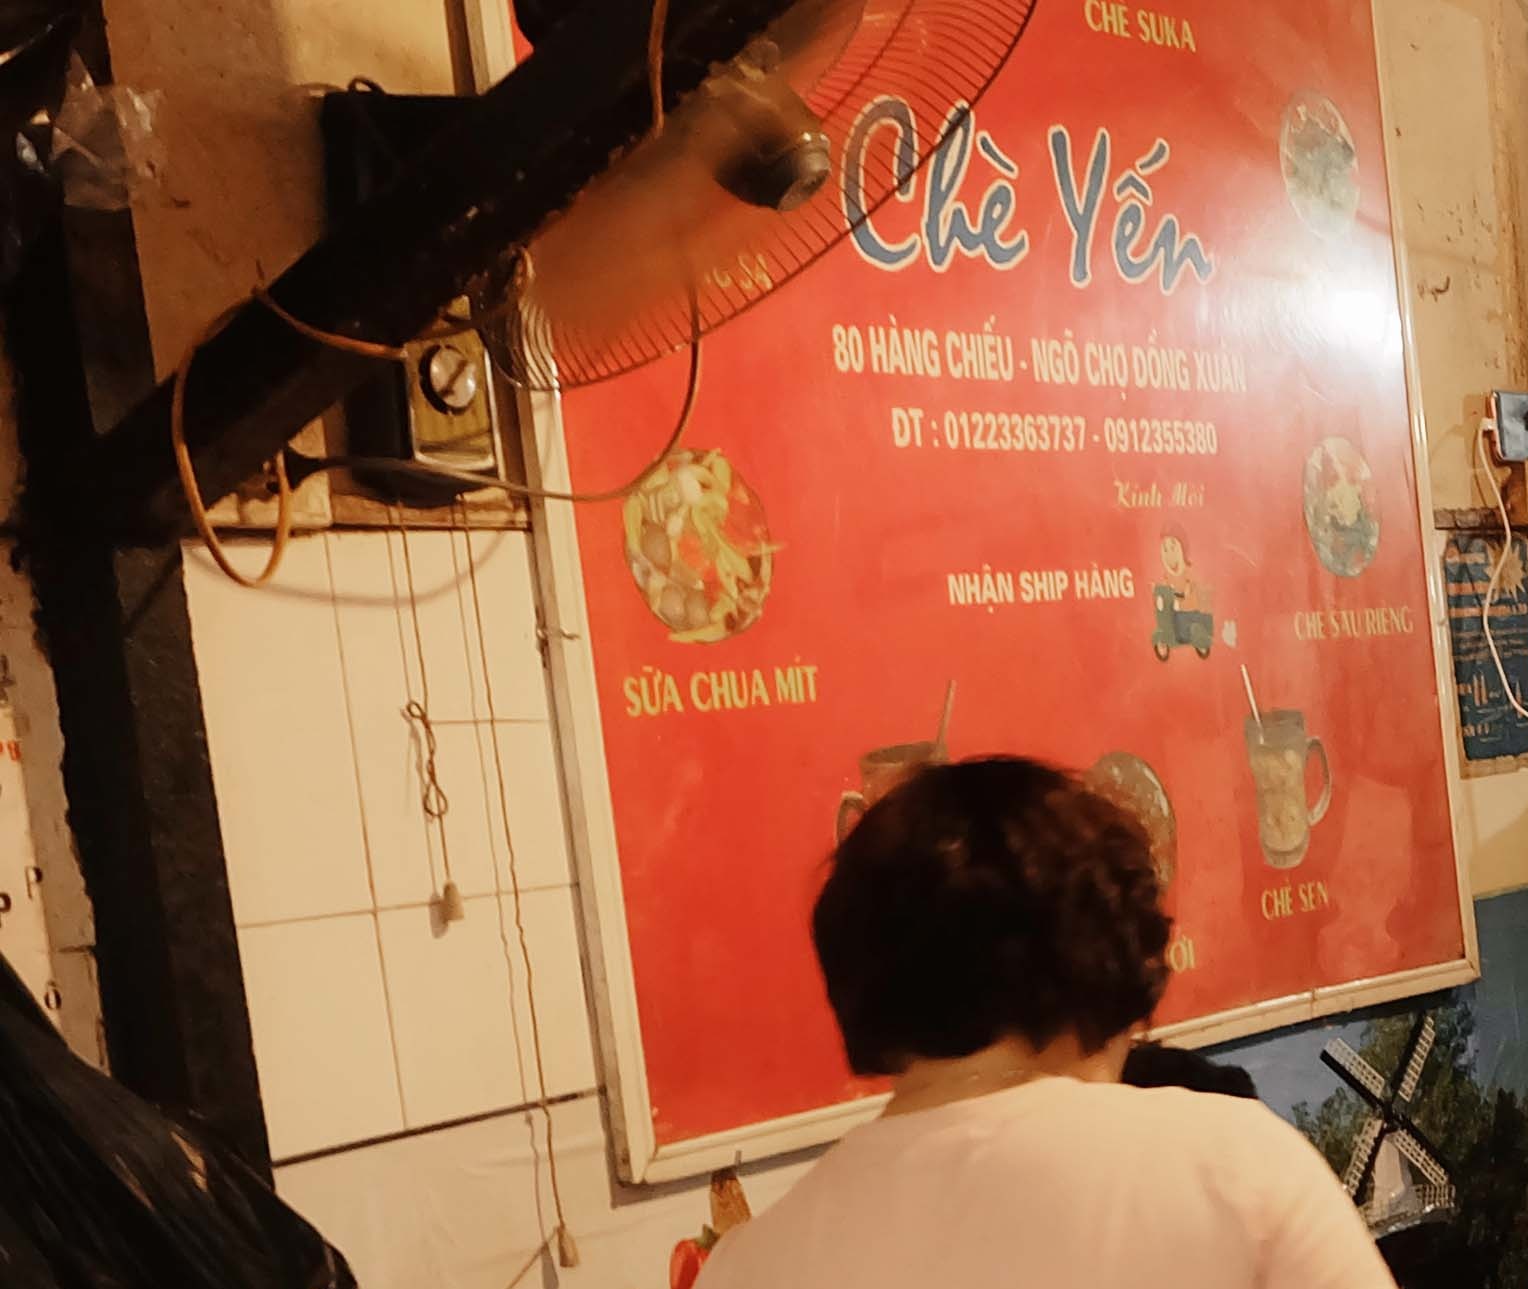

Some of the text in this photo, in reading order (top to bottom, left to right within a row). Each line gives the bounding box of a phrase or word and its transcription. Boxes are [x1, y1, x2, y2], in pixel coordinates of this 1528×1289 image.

[1137, 10, 1197, 52] SUKA
[840, 95, 1213, 296] Chè Yến
[832, 324, 864, 373] 80
[868, 314, 941, 378] HÀNG
[945, 315, 1014, 382] CHIẾU
[944, 410, 1087, 452] 01223363737
[1104, 416, 1218, 455] 0912355380
[948, 561, 1135, 614] NHẬN SHIP HÀNG
[623, 665, 684, 717] SỮA
[690, 668, 770, 712] CHUA
